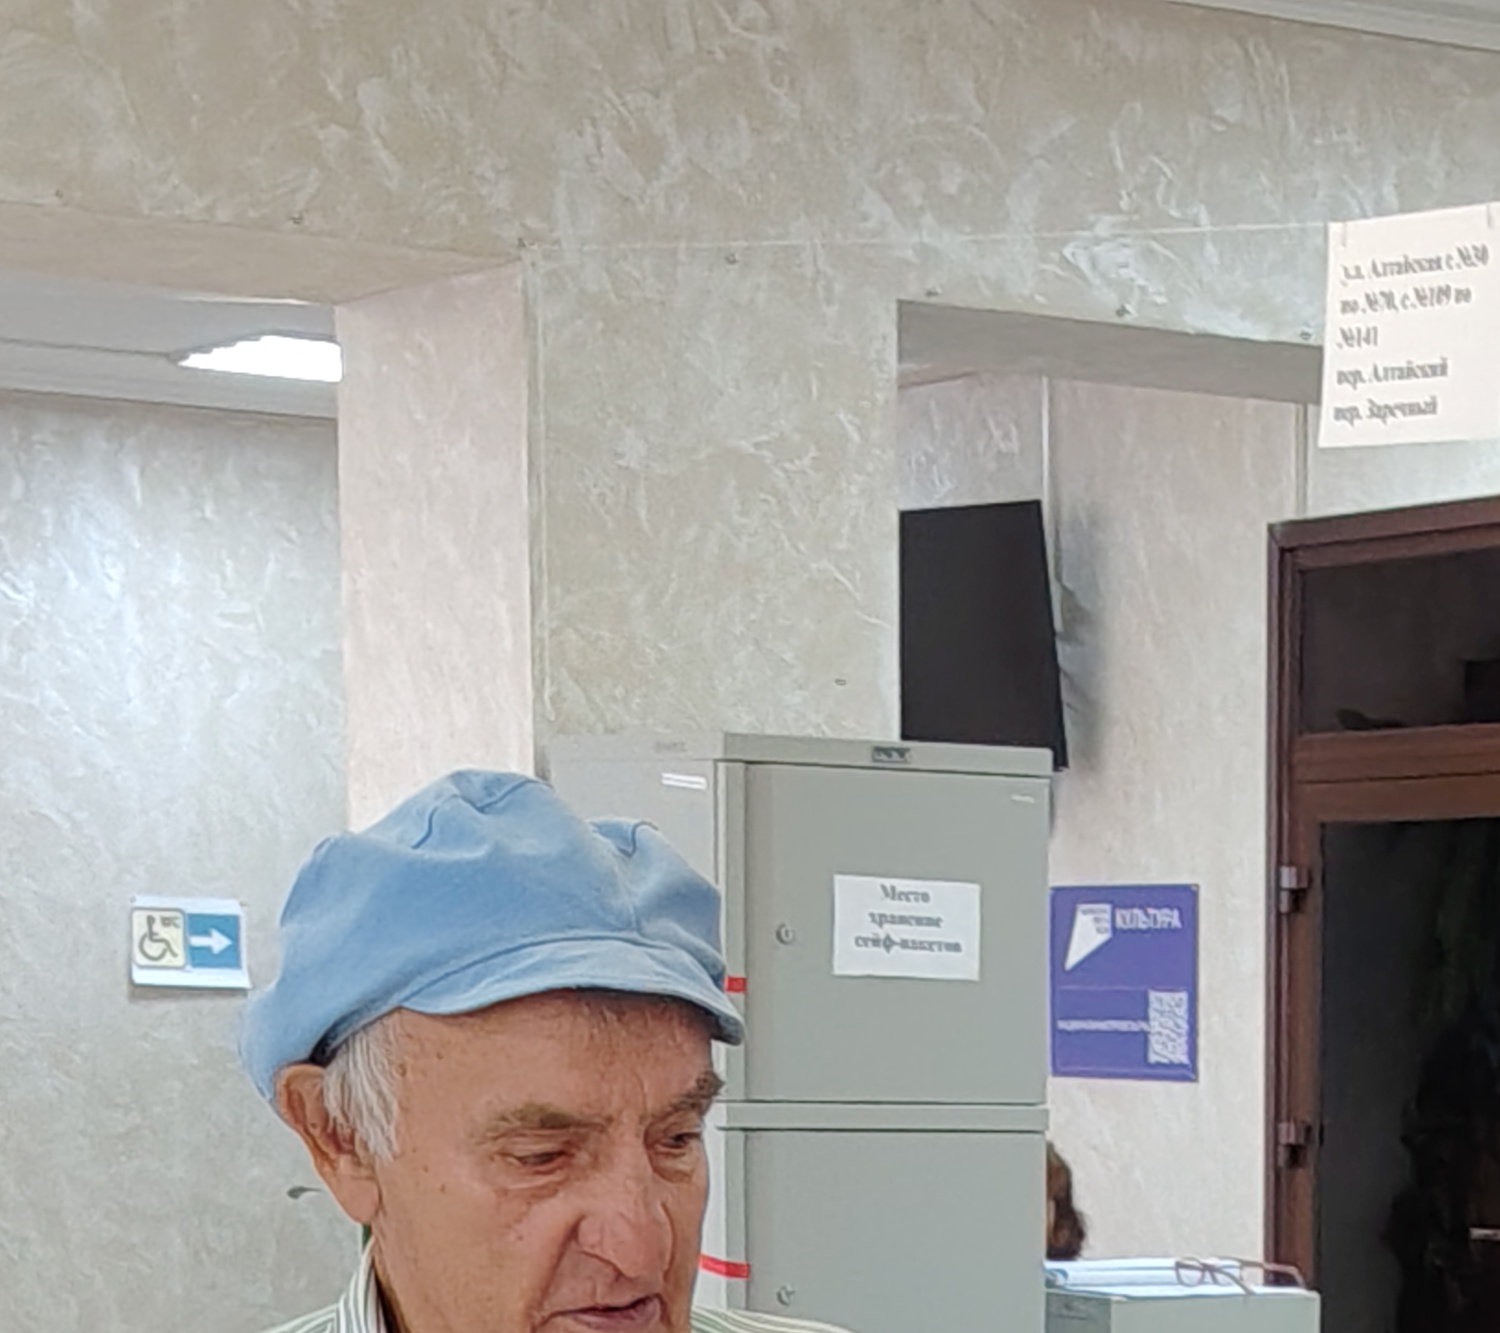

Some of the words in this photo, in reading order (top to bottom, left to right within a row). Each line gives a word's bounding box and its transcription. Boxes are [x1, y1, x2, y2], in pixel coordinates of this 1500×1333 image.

[880, 883, 931, 903] Место
[1114, 907, 1183, 930] КУЛЬТУРА
[854, 932, 962, 954] сейф-пакетов
